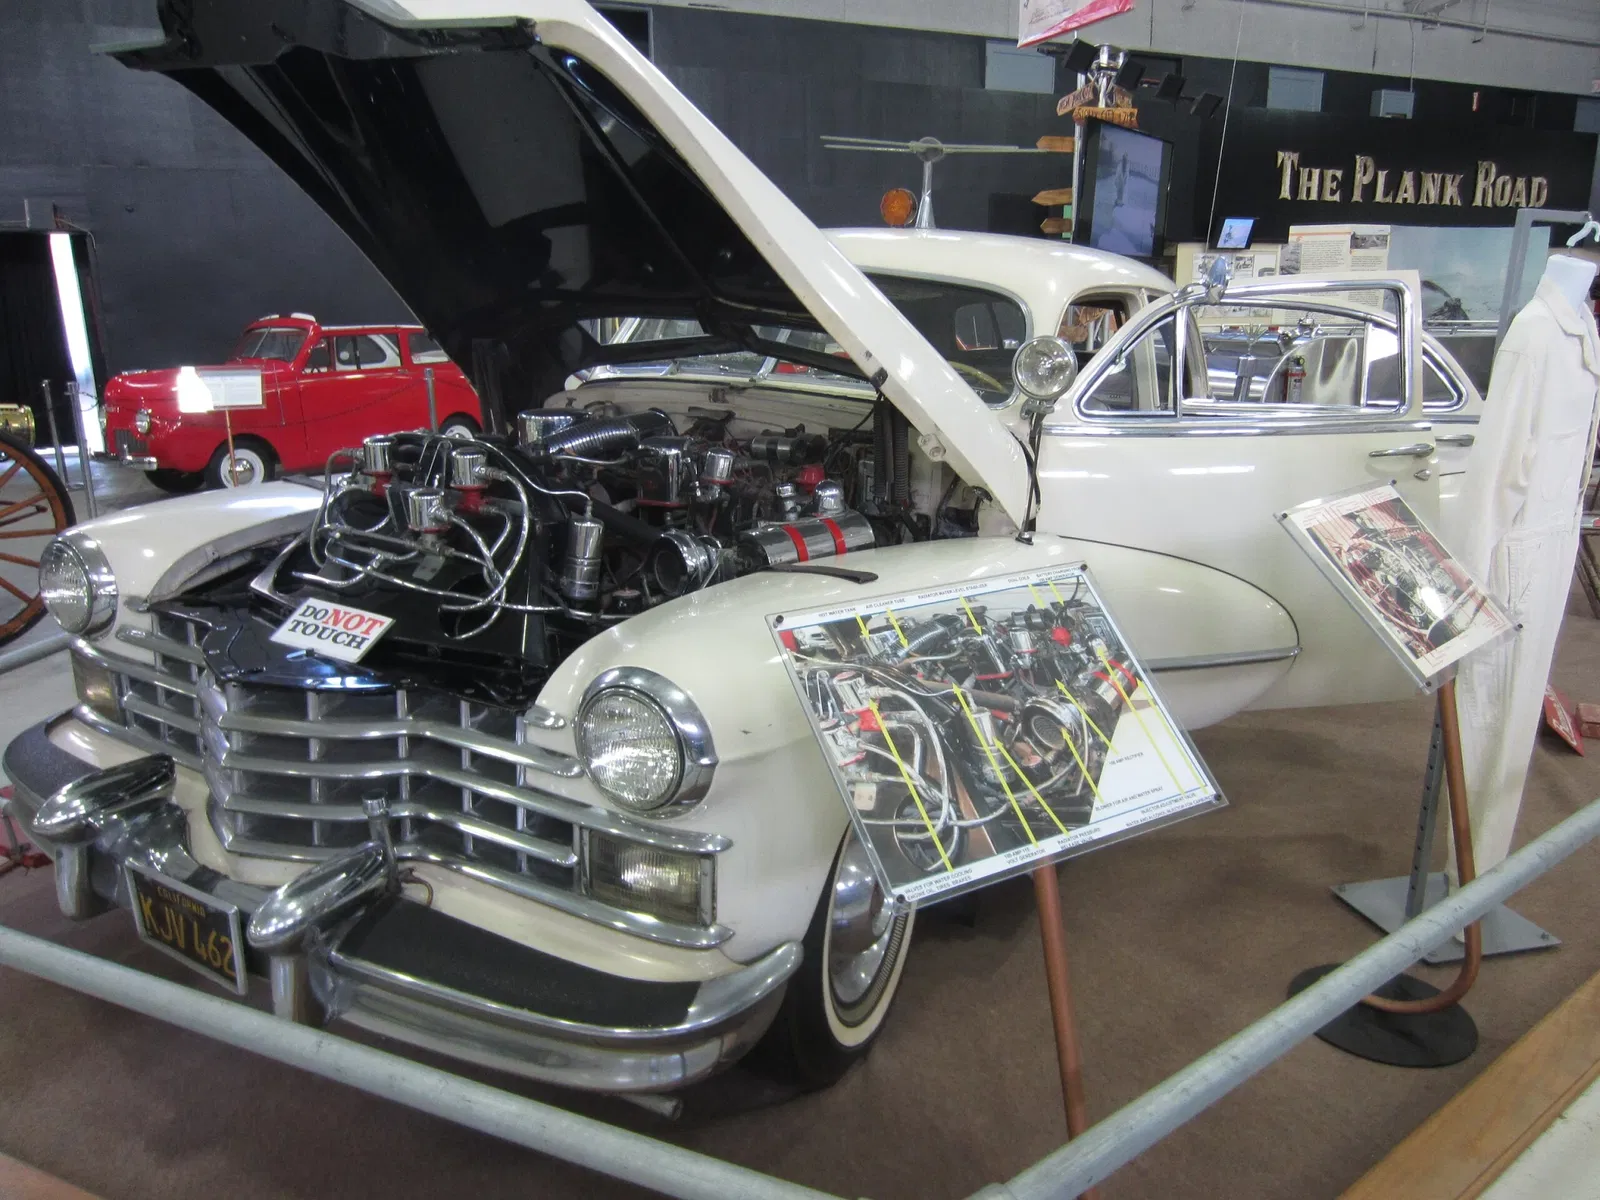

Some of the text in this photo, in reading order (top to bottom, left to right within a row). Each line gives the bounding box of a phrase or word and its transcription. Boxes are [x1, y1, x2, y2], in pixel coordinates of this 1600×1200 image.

[1276, 150, 1548, 208] THE PLANK ROAD
[917, 591, 939, 599] RADIATOR
[874, 600, 893, 608] CLEANER
[828, 609, 844, 617] WATER
[299, 605, 384, 636] DO NOT
[288, 619, 370, 650] TOUCH
[1137, 790, 1151, 798] WATER
[1151, 785, 1163, 793] SPRAY
[1057, 834, 1078, 844] RADIATOR
[1019, 848, 1046, 860] GENERATOR
[934, 875, 951, 884] WATER
[139, 891, 237, 978] KJV 462
